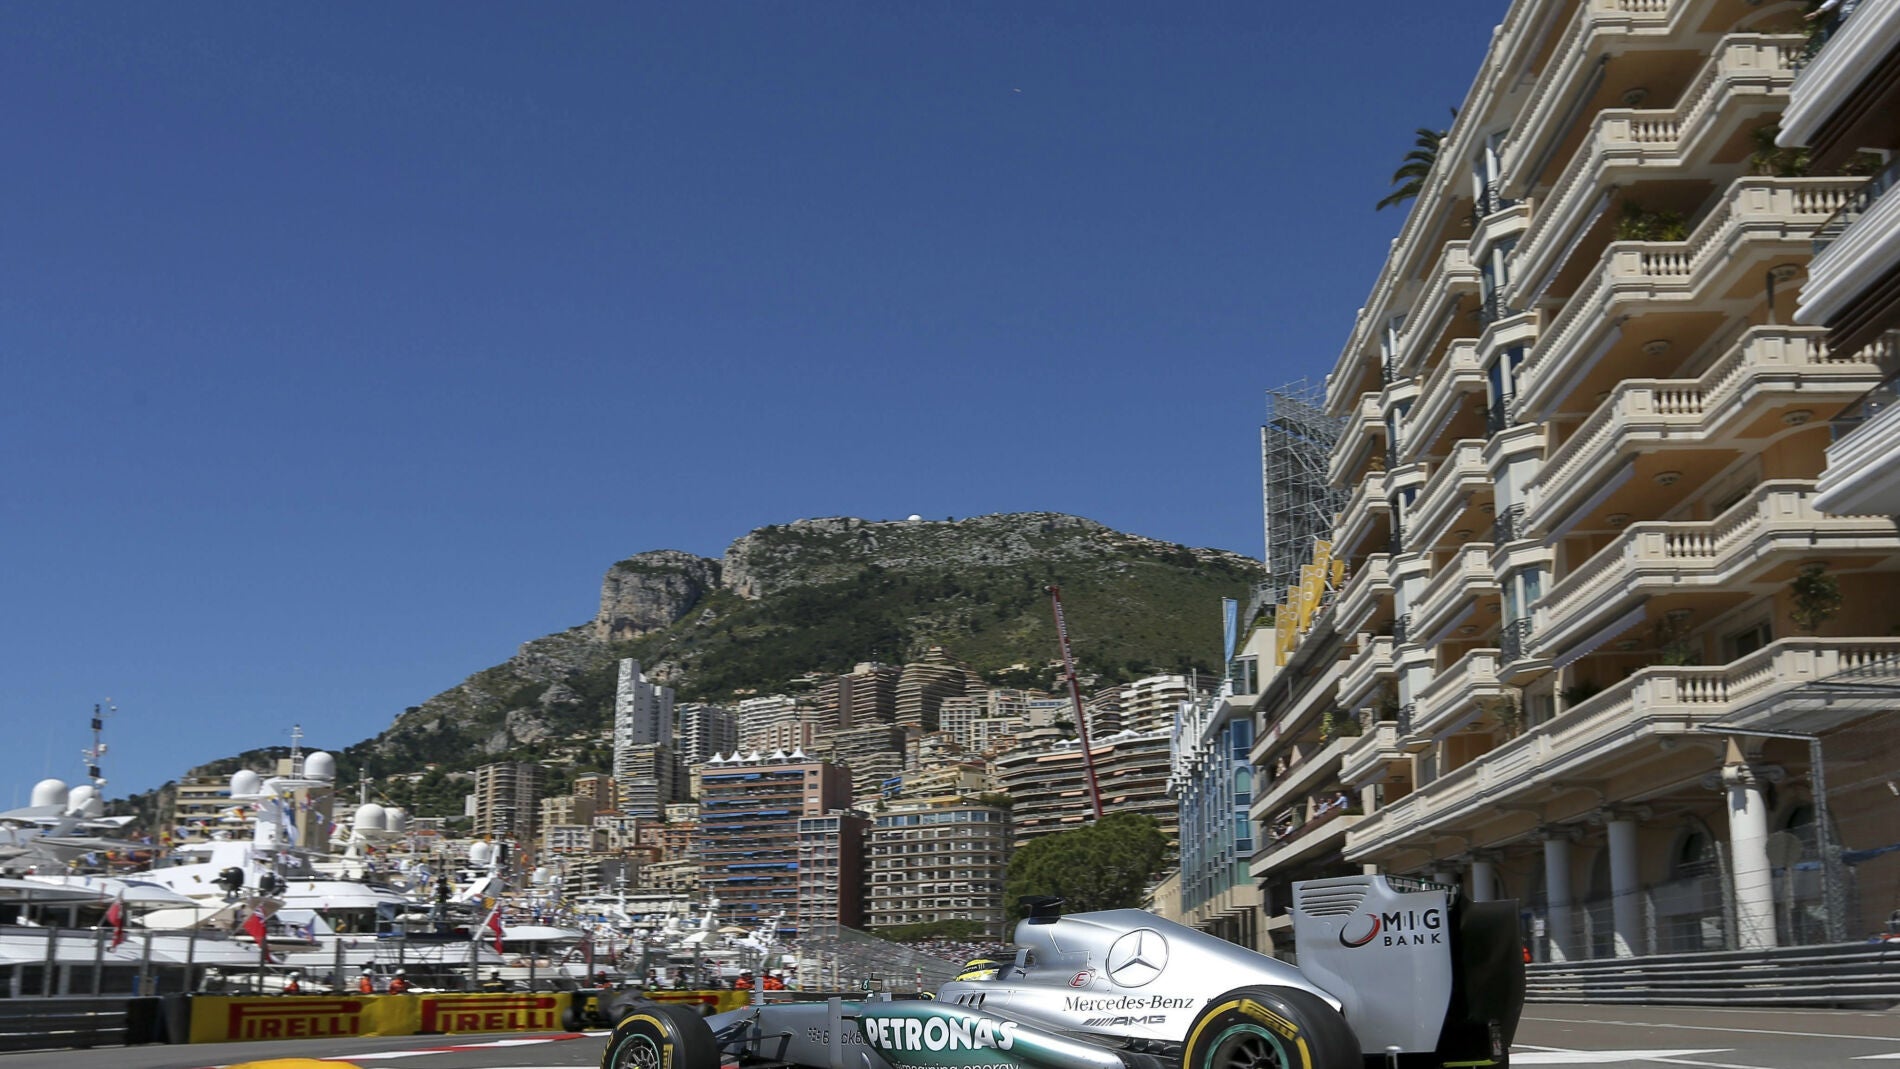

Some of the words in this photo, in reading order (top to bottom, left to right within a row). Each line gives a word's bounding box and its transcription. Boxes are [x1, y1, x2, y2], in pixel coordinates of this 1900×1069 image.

[1384, 933, 1442, 947] BANK
[862, 979, 869, 990] 6
[422, 997, 556, 1032] PIRELLI
[1063, 995, 1194, 1012] Mercedes-Benz
[228, 1001, 362, 1039] PIRELLI
[865, 1016, 1018, 1051] PETRONAS
